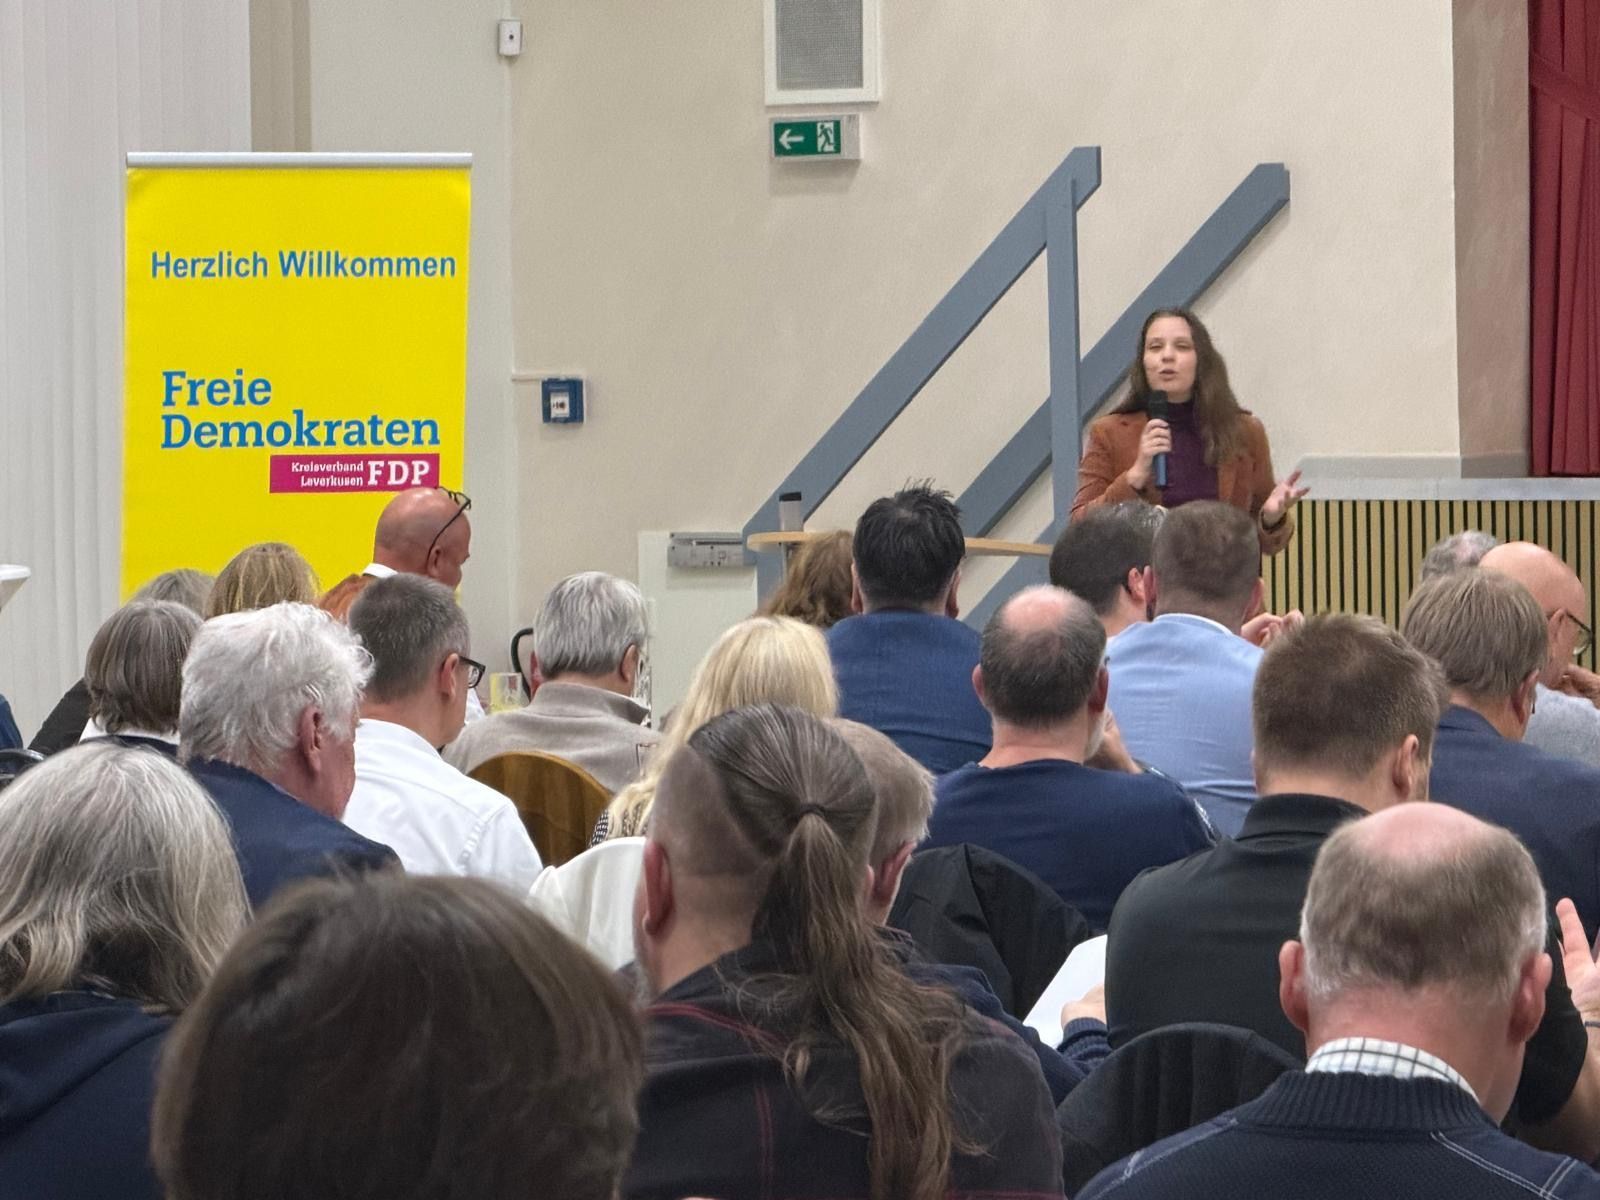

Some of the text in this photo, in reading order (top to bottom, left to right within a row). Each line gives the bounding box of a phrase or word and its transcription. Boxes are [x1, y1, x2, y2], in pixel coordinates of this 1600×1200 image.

[151, 250, 456, 278] Herzlich Willkommen
[162, 368, 272, 406] Freie
[161, 409, 440, 449] Demokraten
[291, 461, 364, 473] Kreisverband
[367, 459, 430, 486] FDP
[300, 475, 364, 487] Leverkusen
